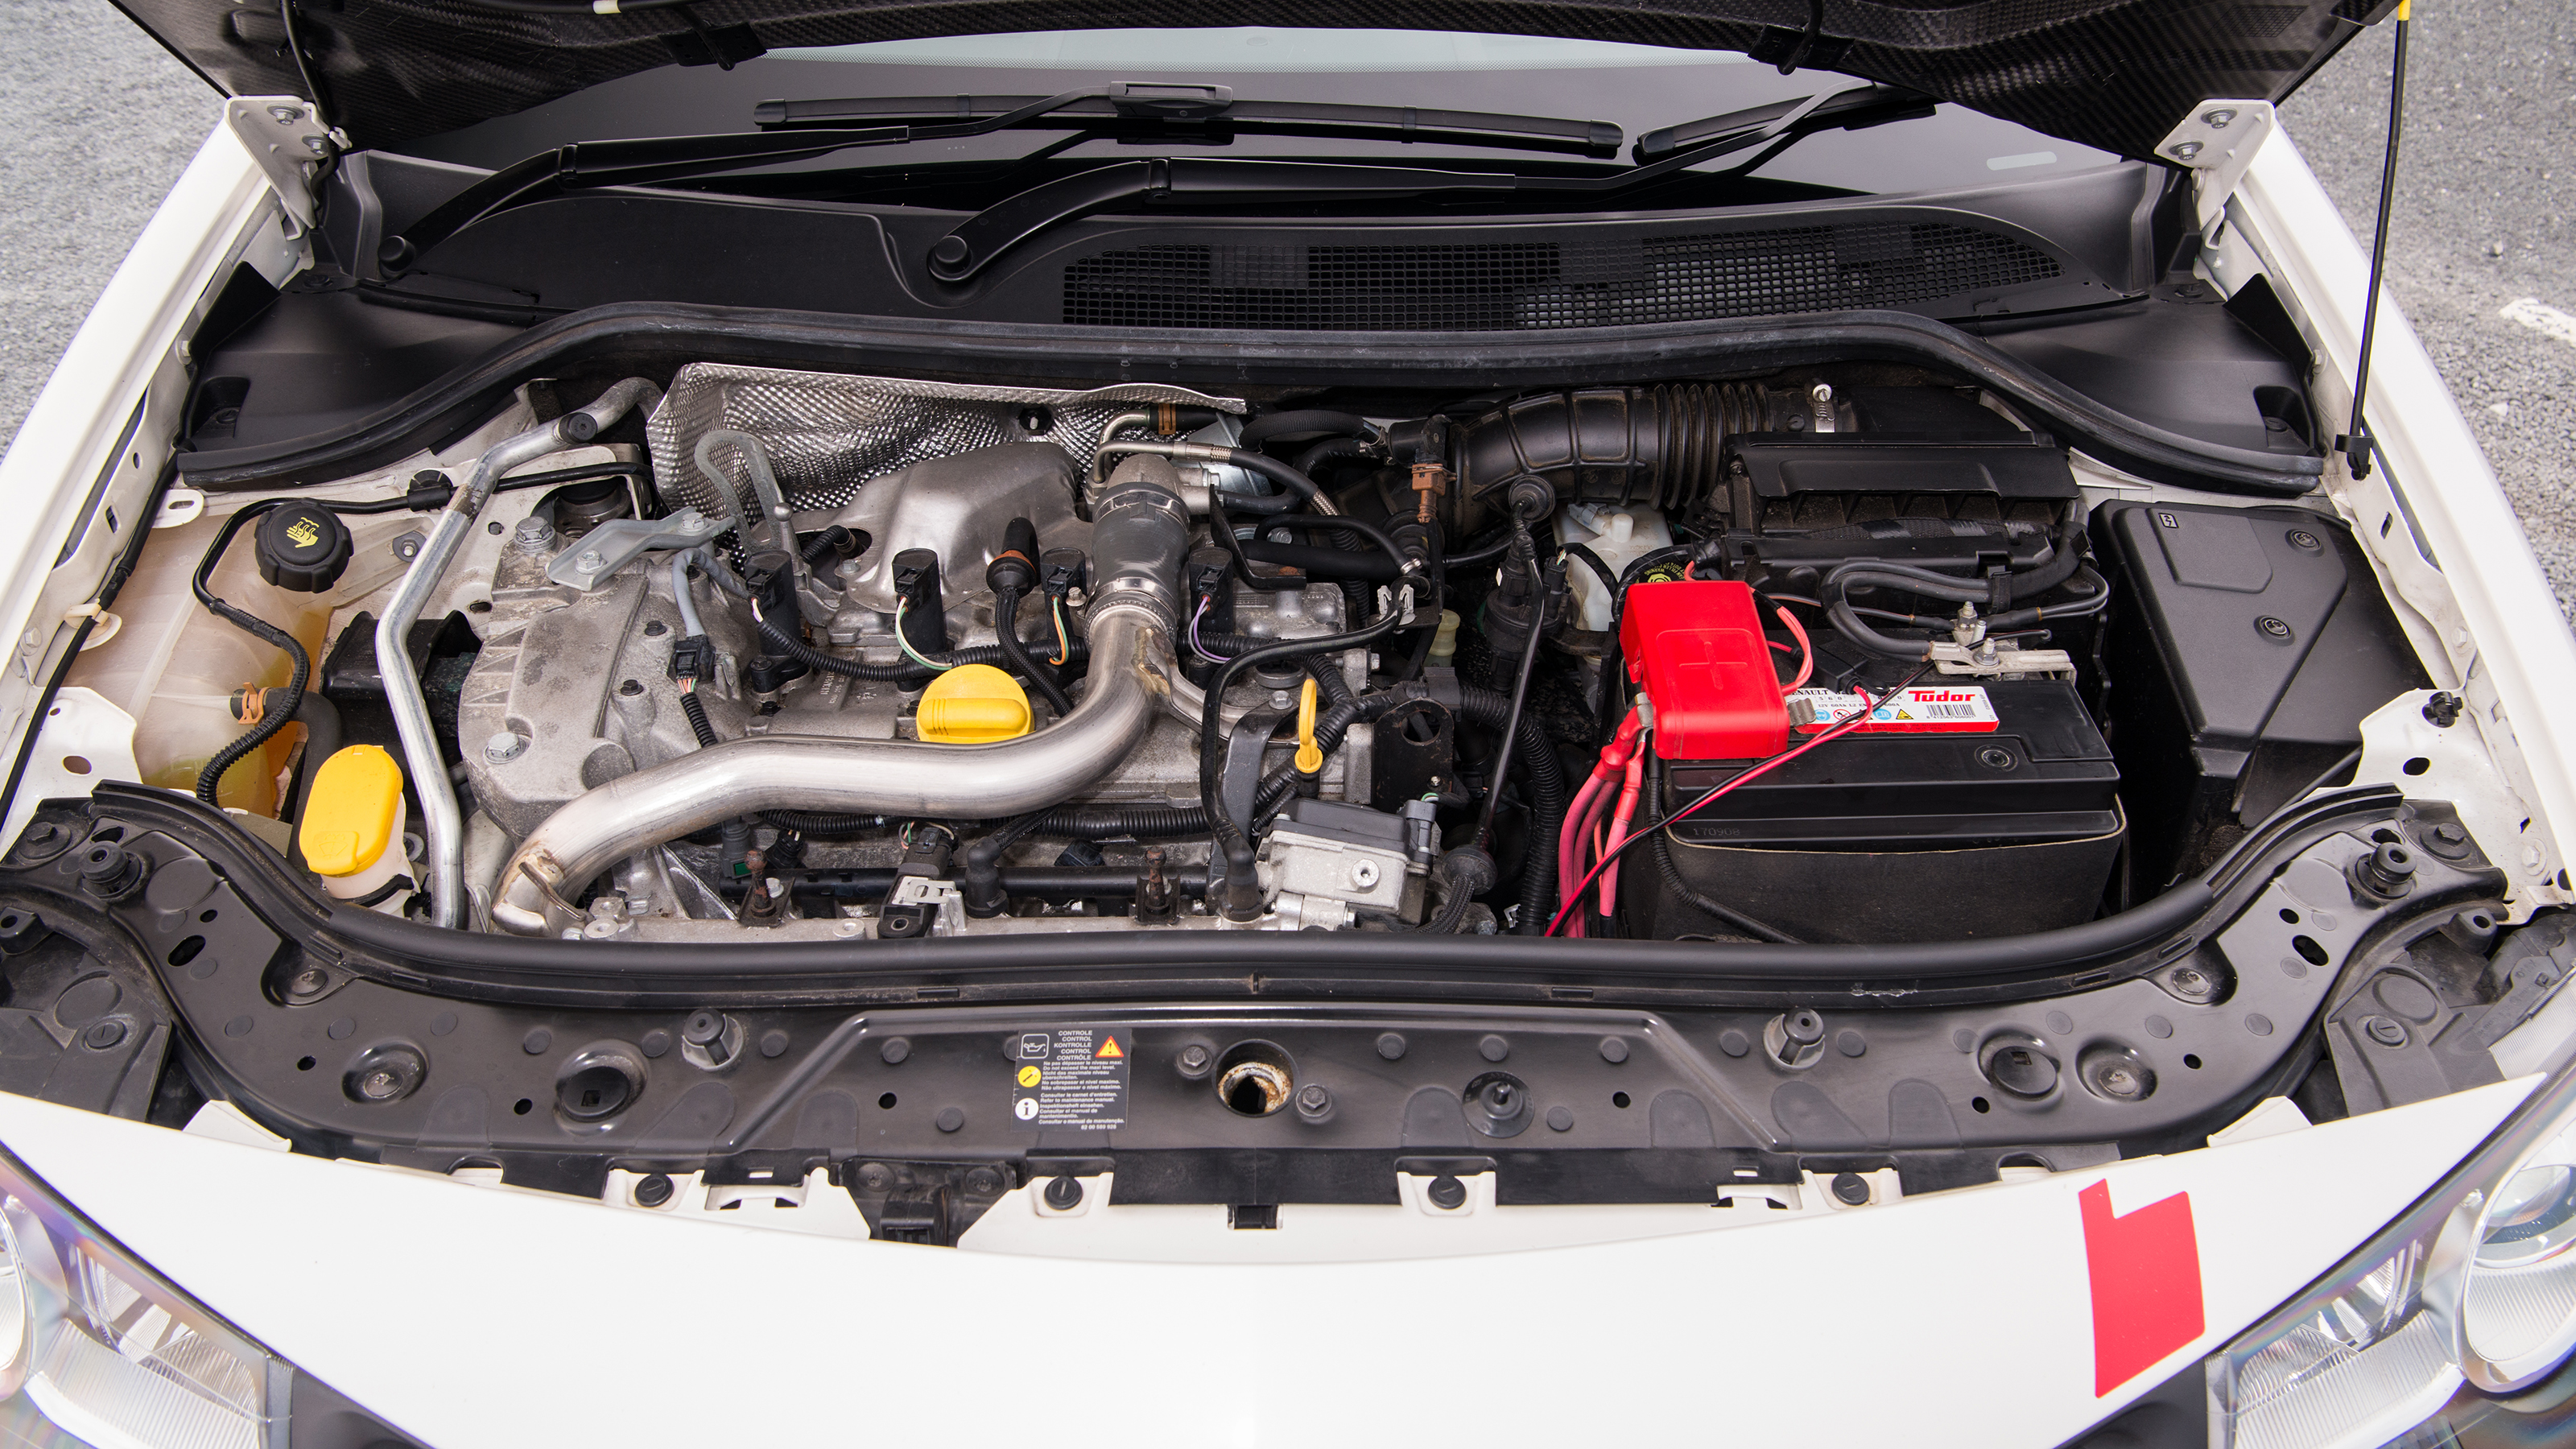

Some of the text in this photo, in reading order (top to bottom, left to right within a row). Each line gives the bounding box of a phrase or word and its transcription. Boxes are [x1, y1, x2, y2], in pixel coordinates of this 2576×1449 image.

[1644, 568, 1665, 576] WARNING
[1908, 690, 1975, 702] Tudor
[1693, 828, 1740, 836] 170908
